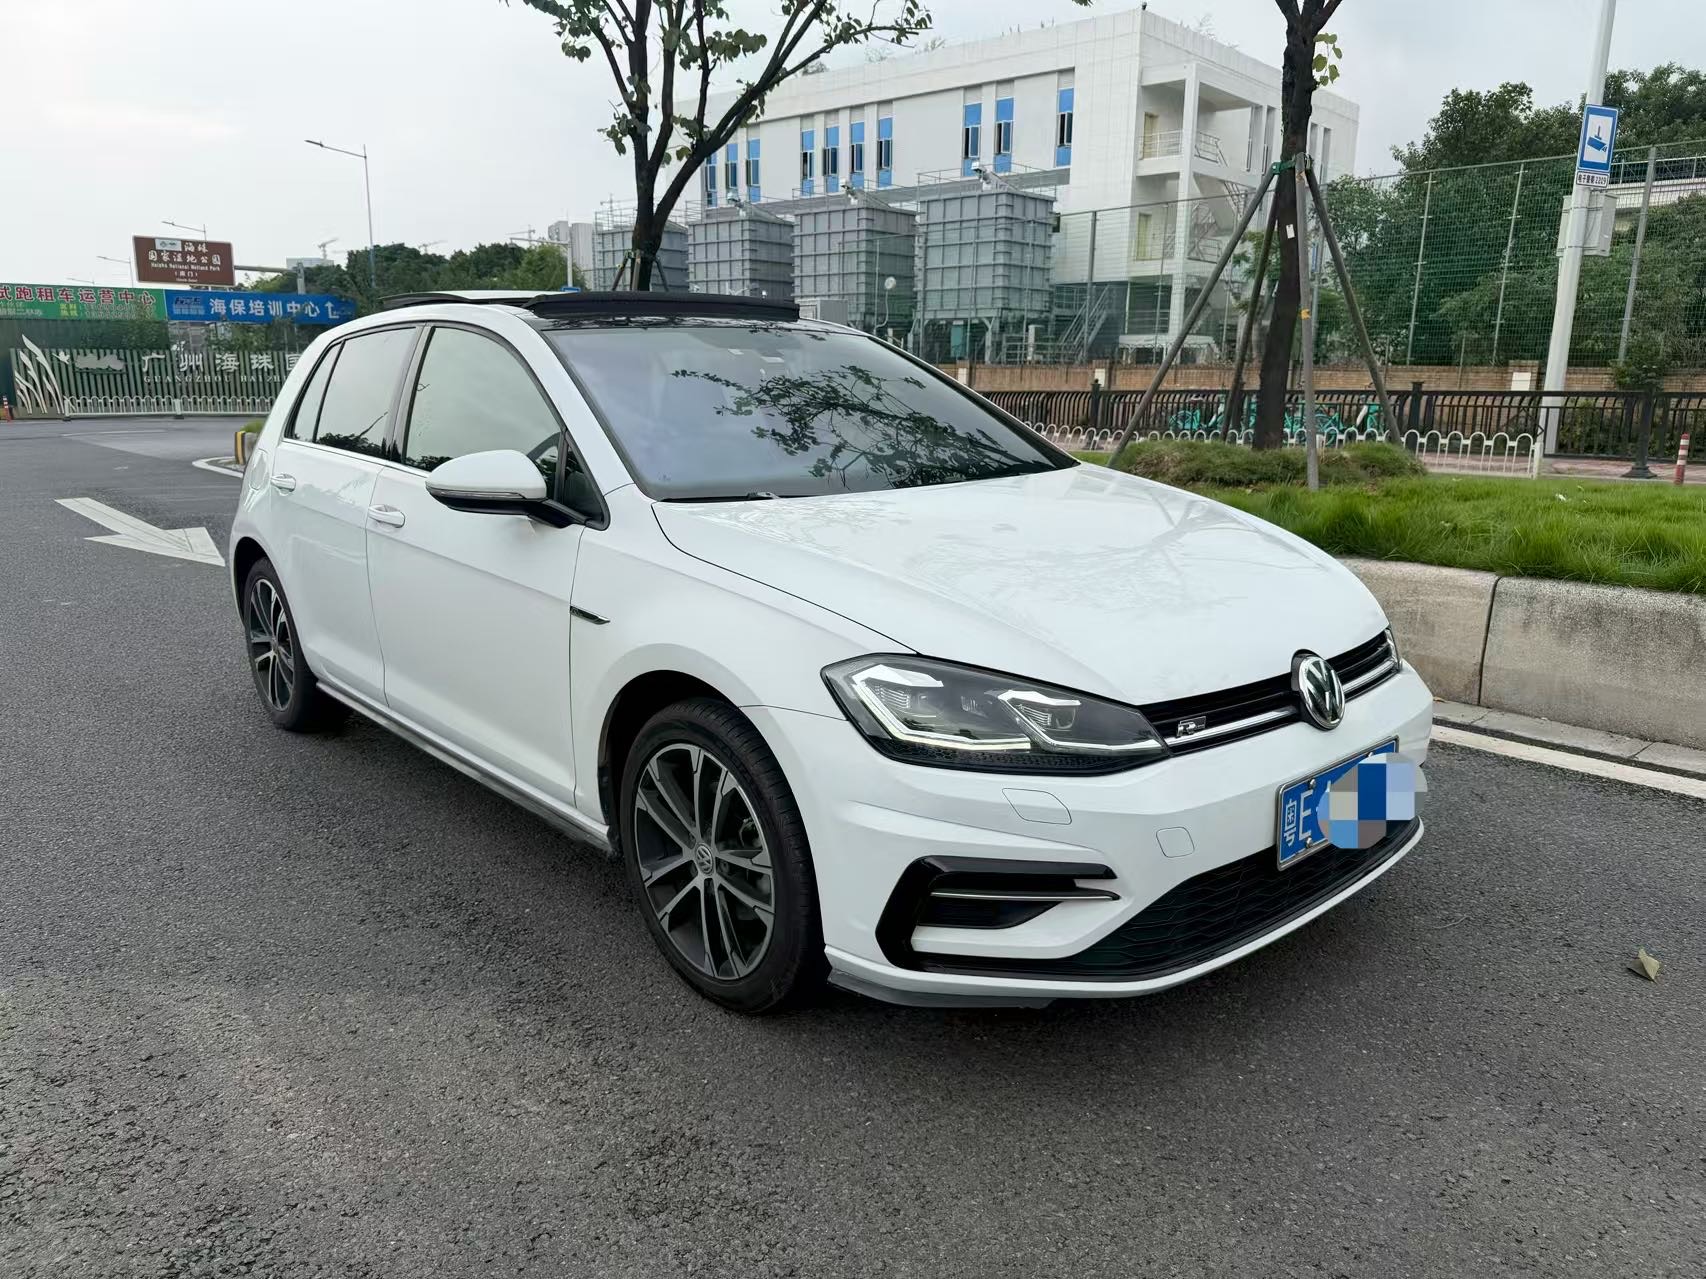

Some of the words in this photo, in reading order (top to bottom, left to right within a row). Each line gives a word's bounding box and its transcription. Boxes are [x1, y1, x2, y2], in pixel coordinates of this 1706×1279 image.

[184, 242, 209, 254] 海珠
[148, 250, 221, 265] 国家湿地公园
[209, 298, 320, 317] 海保培训中心
[143, 375, 231, 383] GUANGZHOU
